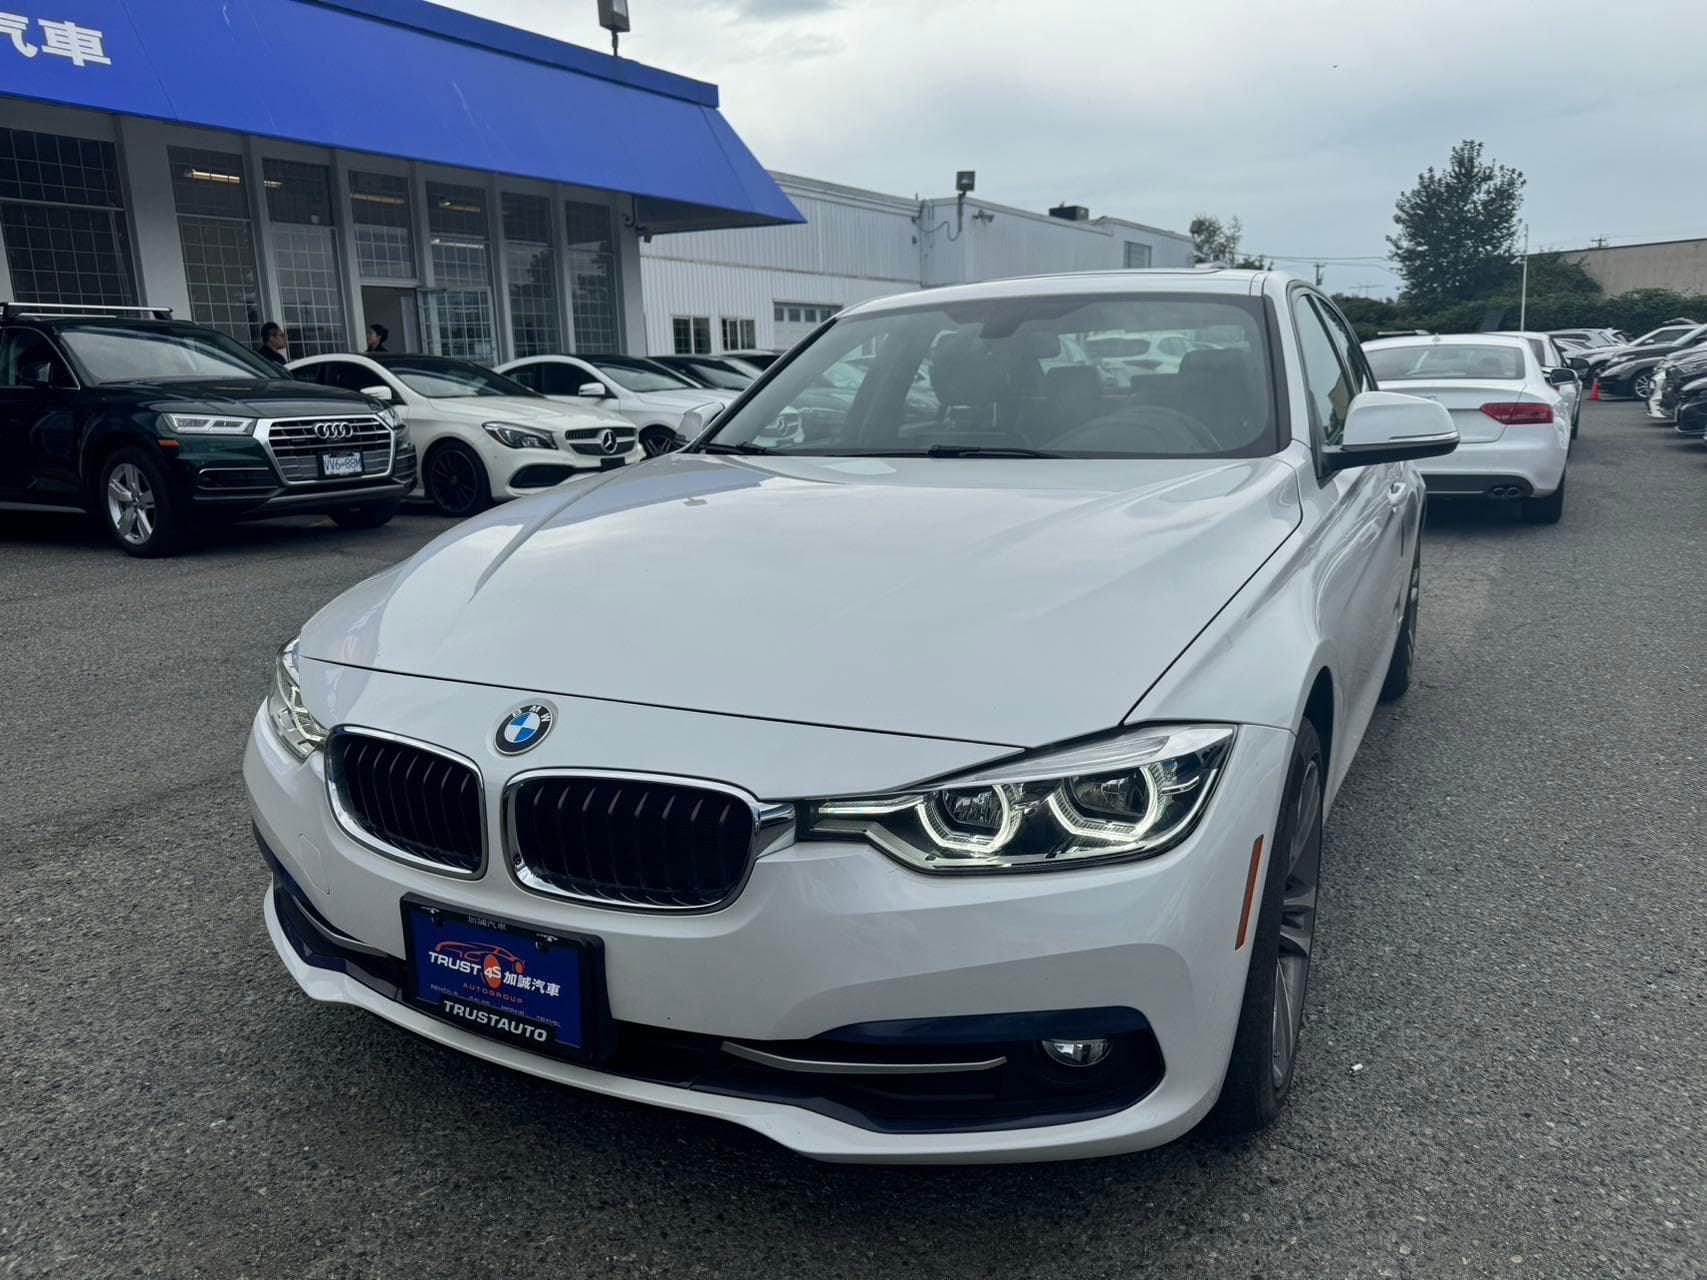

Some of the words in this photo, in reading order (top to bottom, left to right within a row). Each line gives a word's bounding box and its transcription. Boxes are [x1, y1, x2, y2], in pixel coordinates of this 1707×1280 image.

[428, 951, 481, 975] TRUST
[484, 966, 501, 978] 4S
[502, 971, 560, 997] 加誠汽車
[463, 982, 523, 1003] AUTOGROUP
[443, 1000, 547, 1042] TRUSTAUTO
